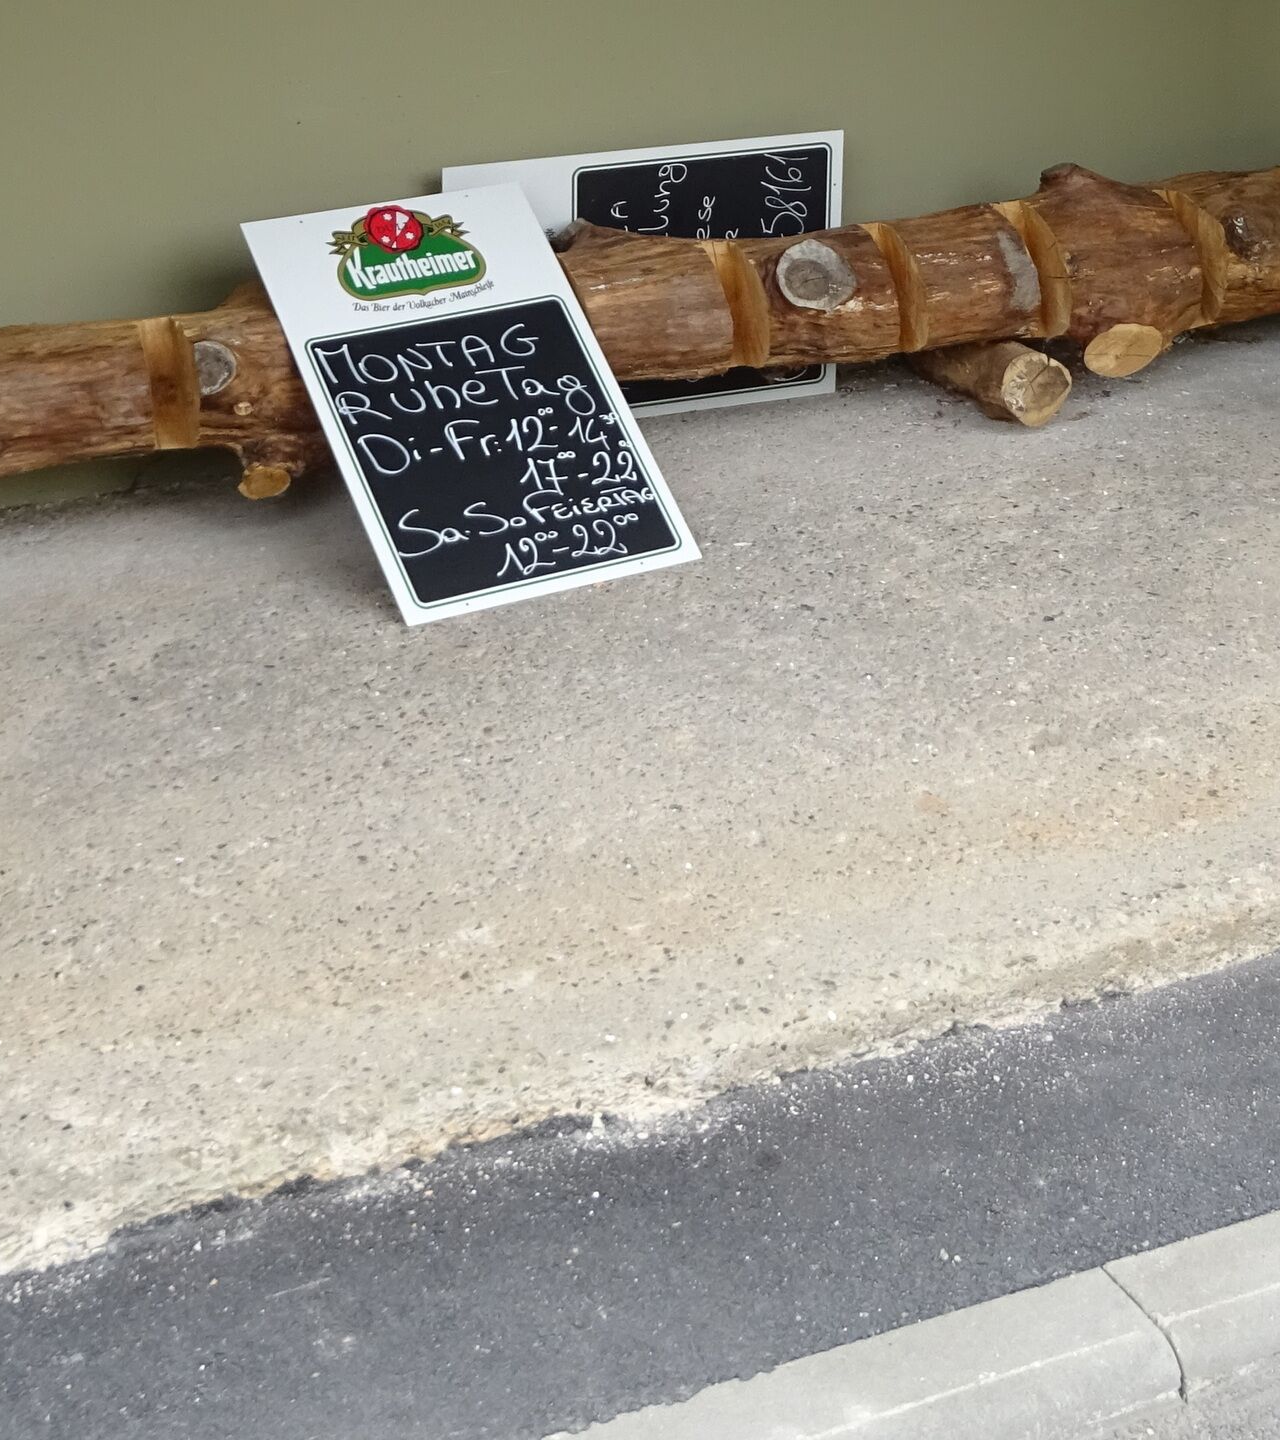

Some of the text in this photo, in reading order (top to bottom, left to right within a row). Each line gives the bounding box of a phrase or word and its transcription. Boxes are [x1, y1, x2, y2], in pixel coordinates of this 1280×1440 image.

[345, 248, 477, 290] Krautheimer
[352, 279, 495, 312] Das Bier der Volkacher Mainschleife
[314, 322, 540, 385] MONTAG
